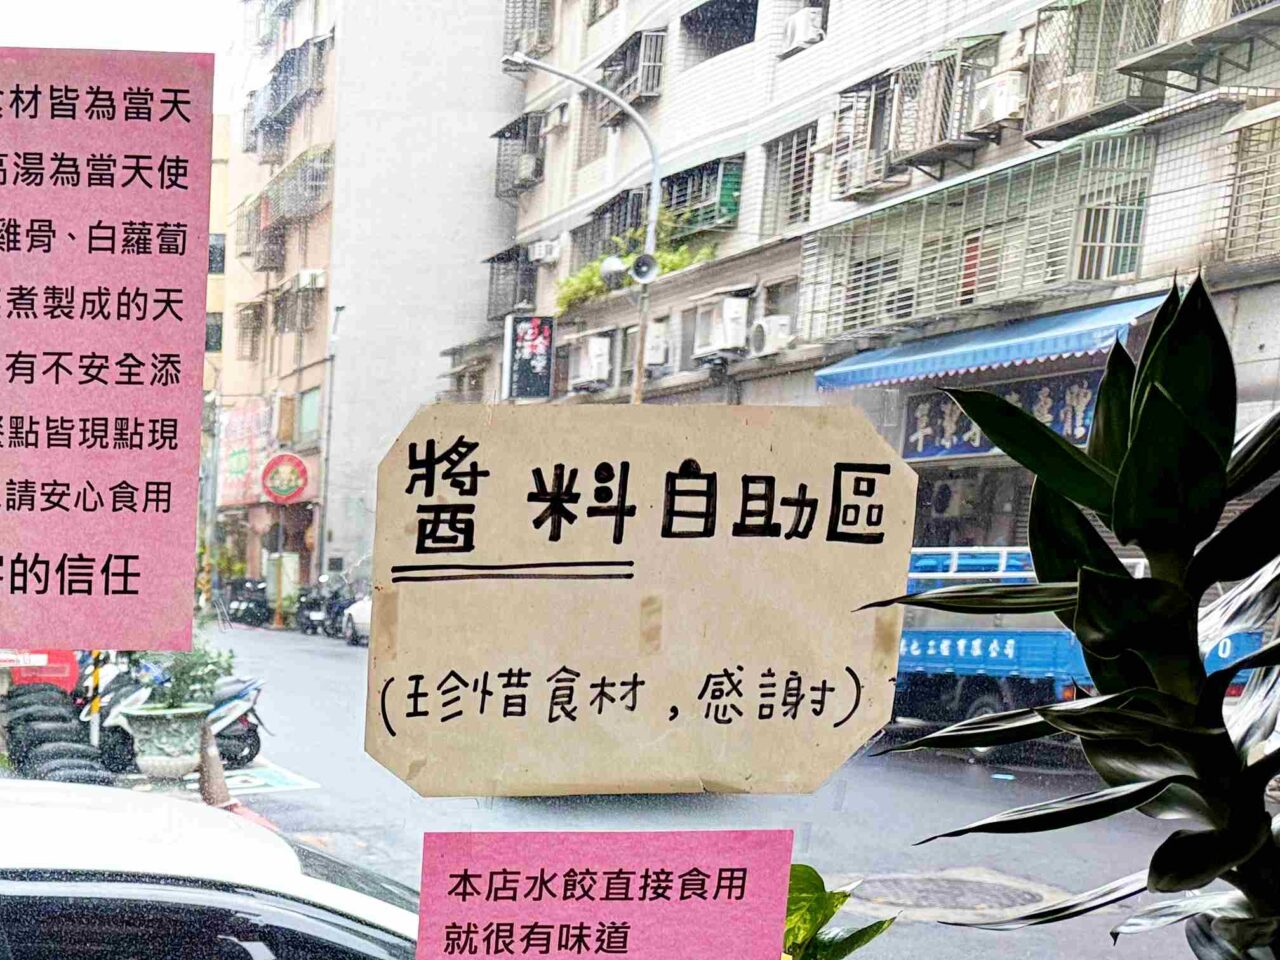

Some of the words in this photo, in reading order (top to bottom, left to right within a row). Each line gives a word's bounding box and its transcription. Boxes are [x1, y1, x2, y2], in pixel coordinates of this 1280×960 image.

[406, 435, 890, 555] 醬料自助區
[447, 868, 747, 901] 本店水餃直接食用
[443, 921, 631, 955] 就很有味道
